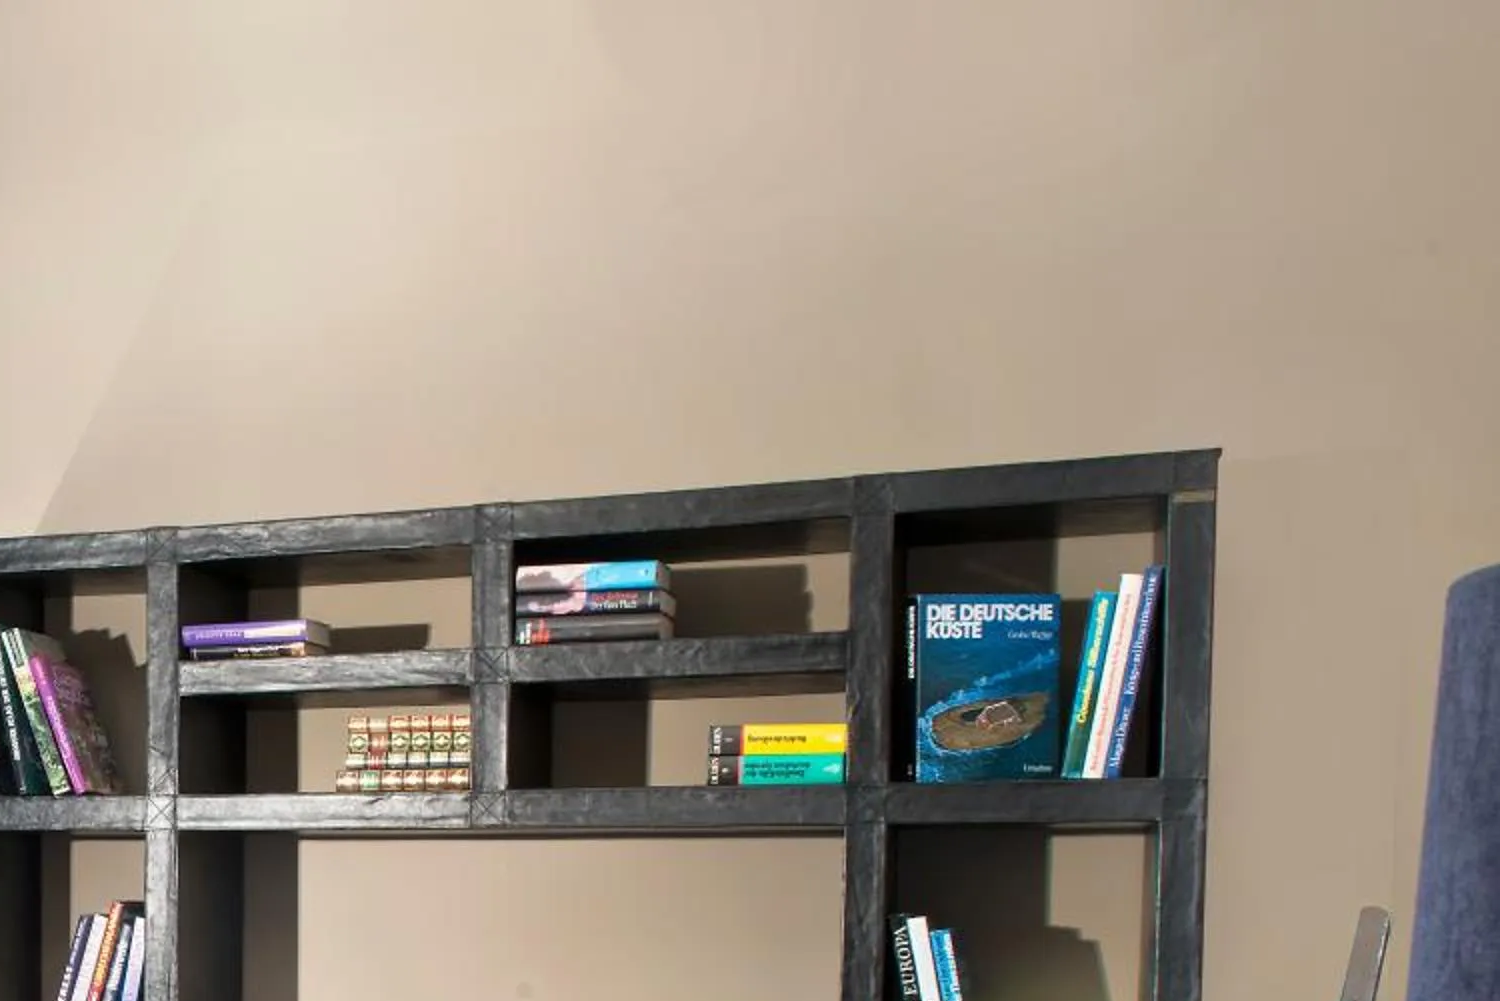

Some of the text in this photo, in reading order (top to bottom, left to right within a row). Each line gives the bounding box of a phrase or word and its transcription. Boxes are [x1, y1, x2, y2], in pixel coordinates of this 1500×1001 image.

[926, 603, 1054, 621] DIE DEUTSCHE
[894, 924, 918, 995] EUROPA
